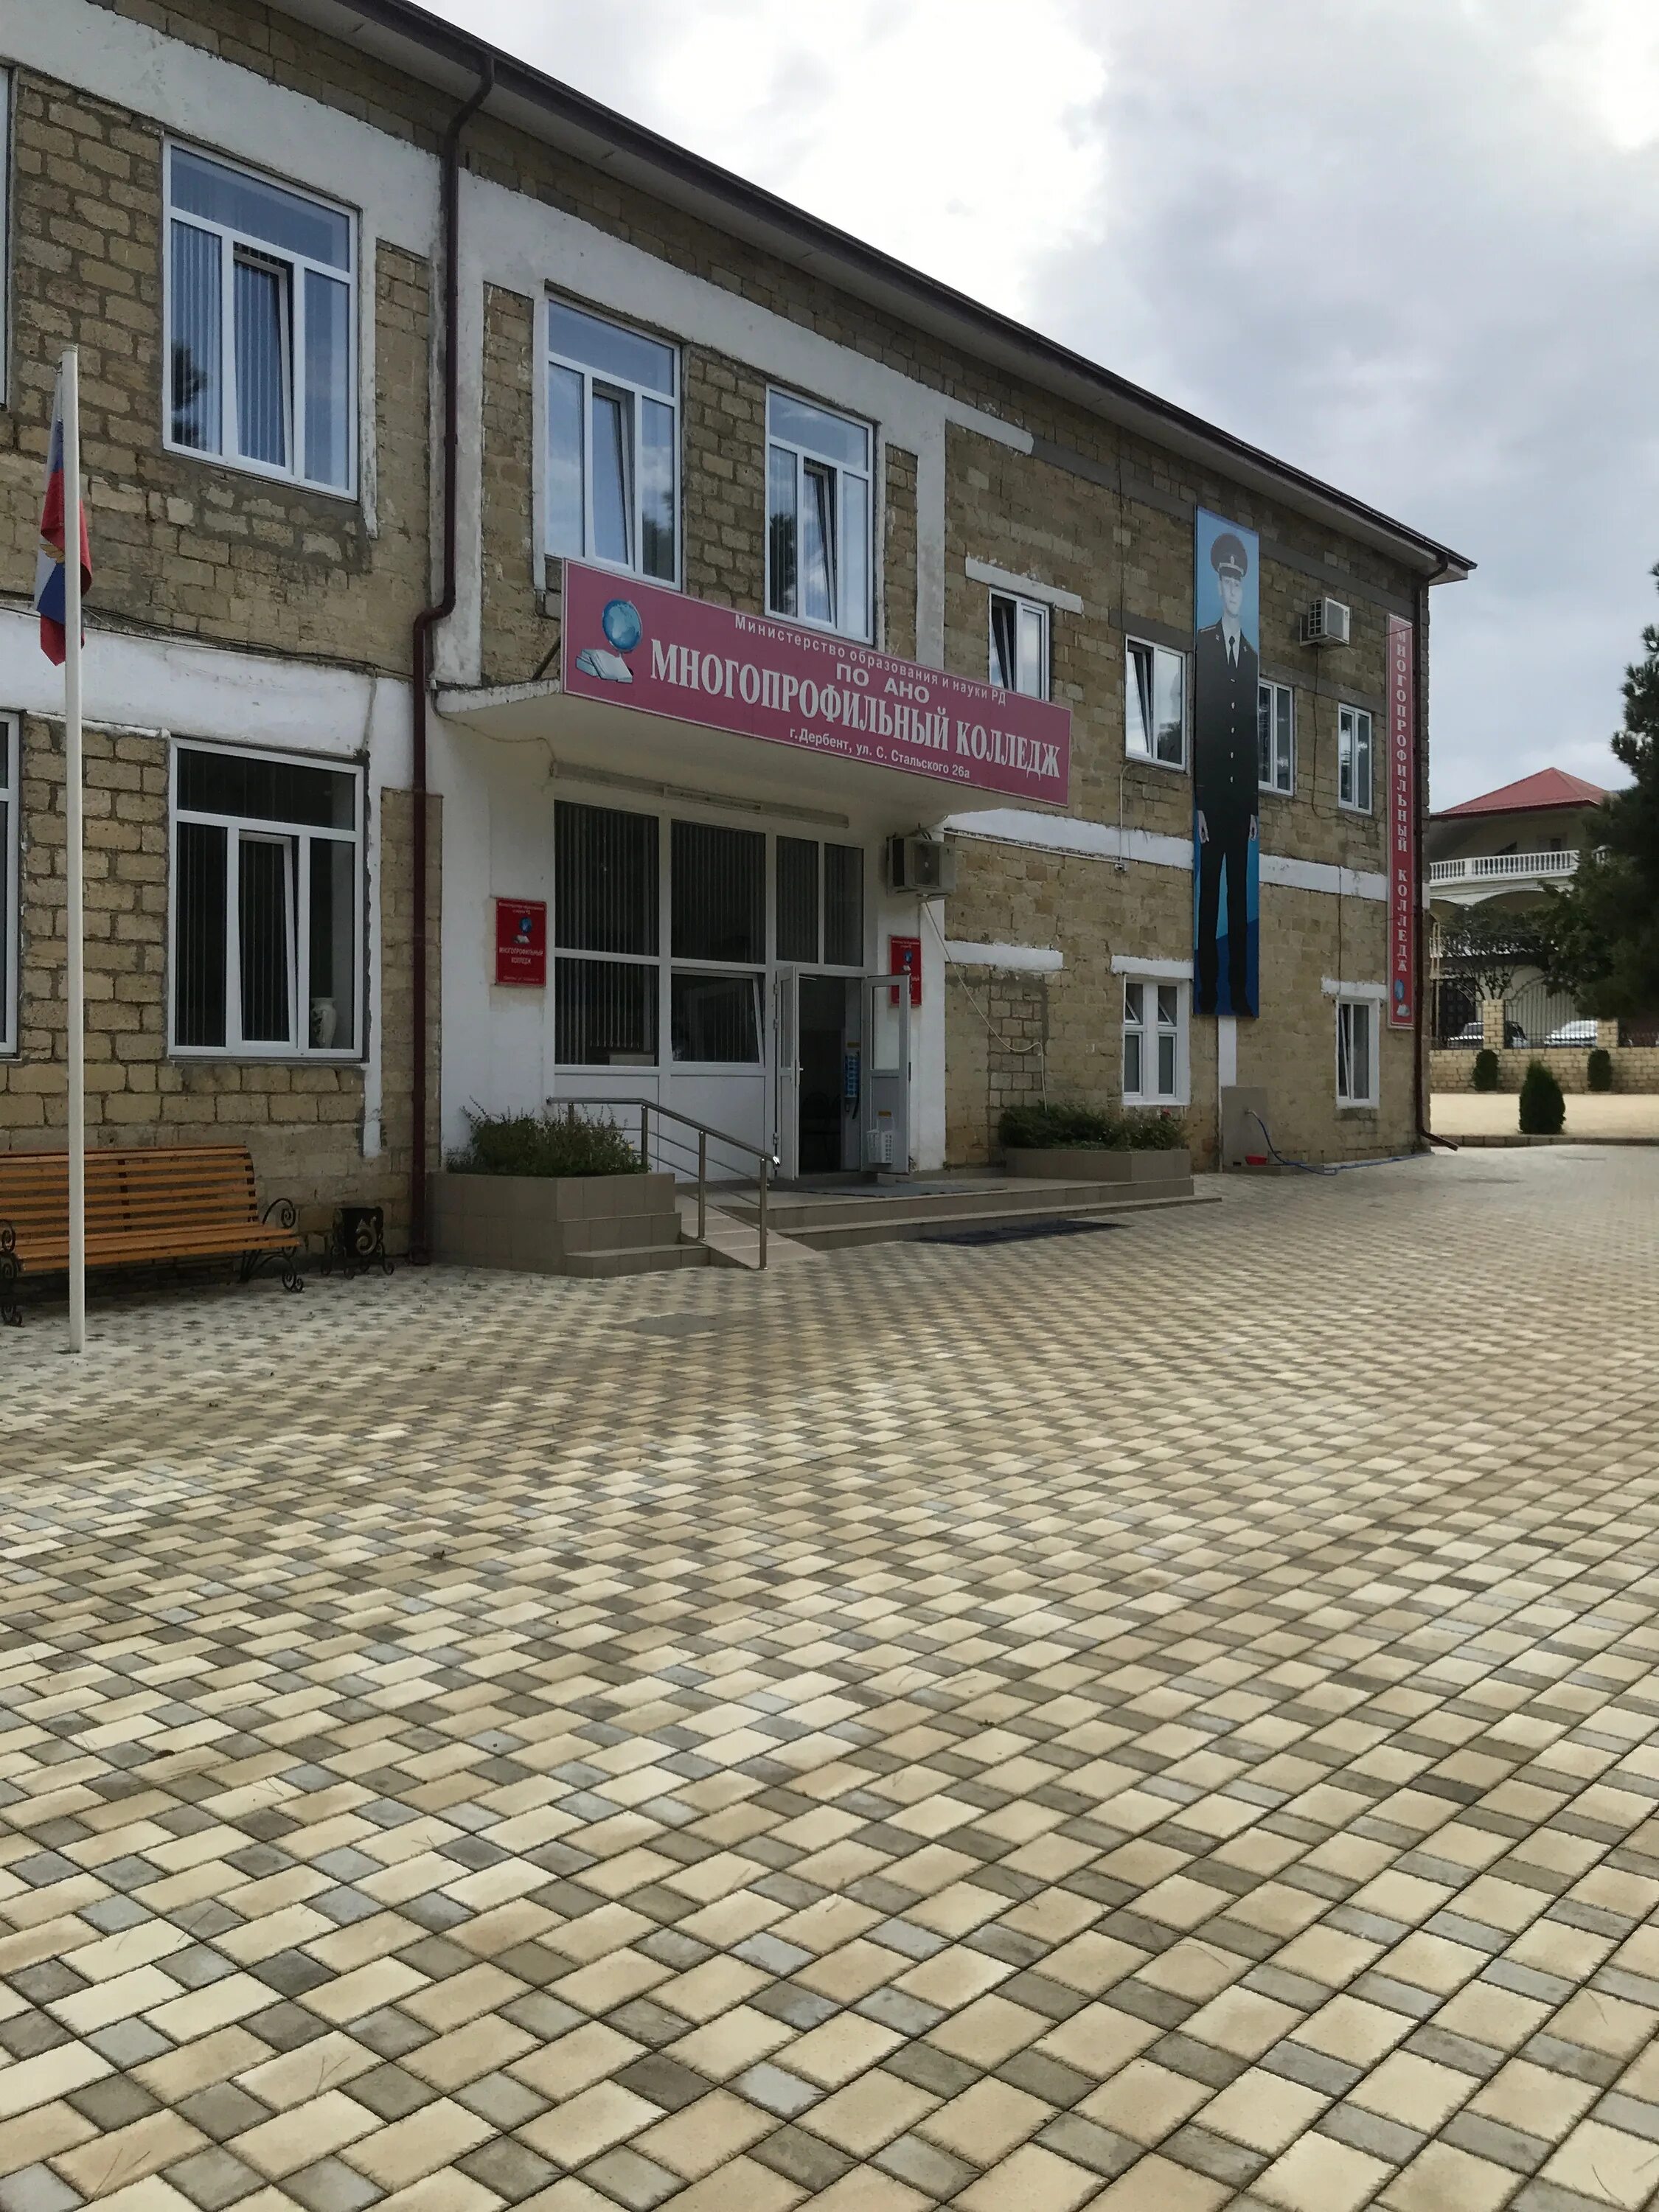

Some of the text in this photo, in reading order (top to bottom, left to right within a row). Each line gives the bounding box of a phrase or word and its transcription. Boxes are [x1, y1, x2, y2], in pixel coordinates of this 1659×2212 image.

[735, 614, 1006, 706] Министерство образования и науки РД
[836, 663, 930, 704] ПО АНО
[650, 639, 1060, 781] МНОГОПРОФИЛЬНЫЙ КОЛЛЕДЖ
[855, 743, 872, 757] ул.
[876, 745, 887, 760] С.
[891, 748, 949, 774] Стальского
[952, 764, 970, 779] 26а
[1397, 630, 1408, 973] МНОГОПРОФИЛЬНЫЙ КОЛЛЕДЖ
